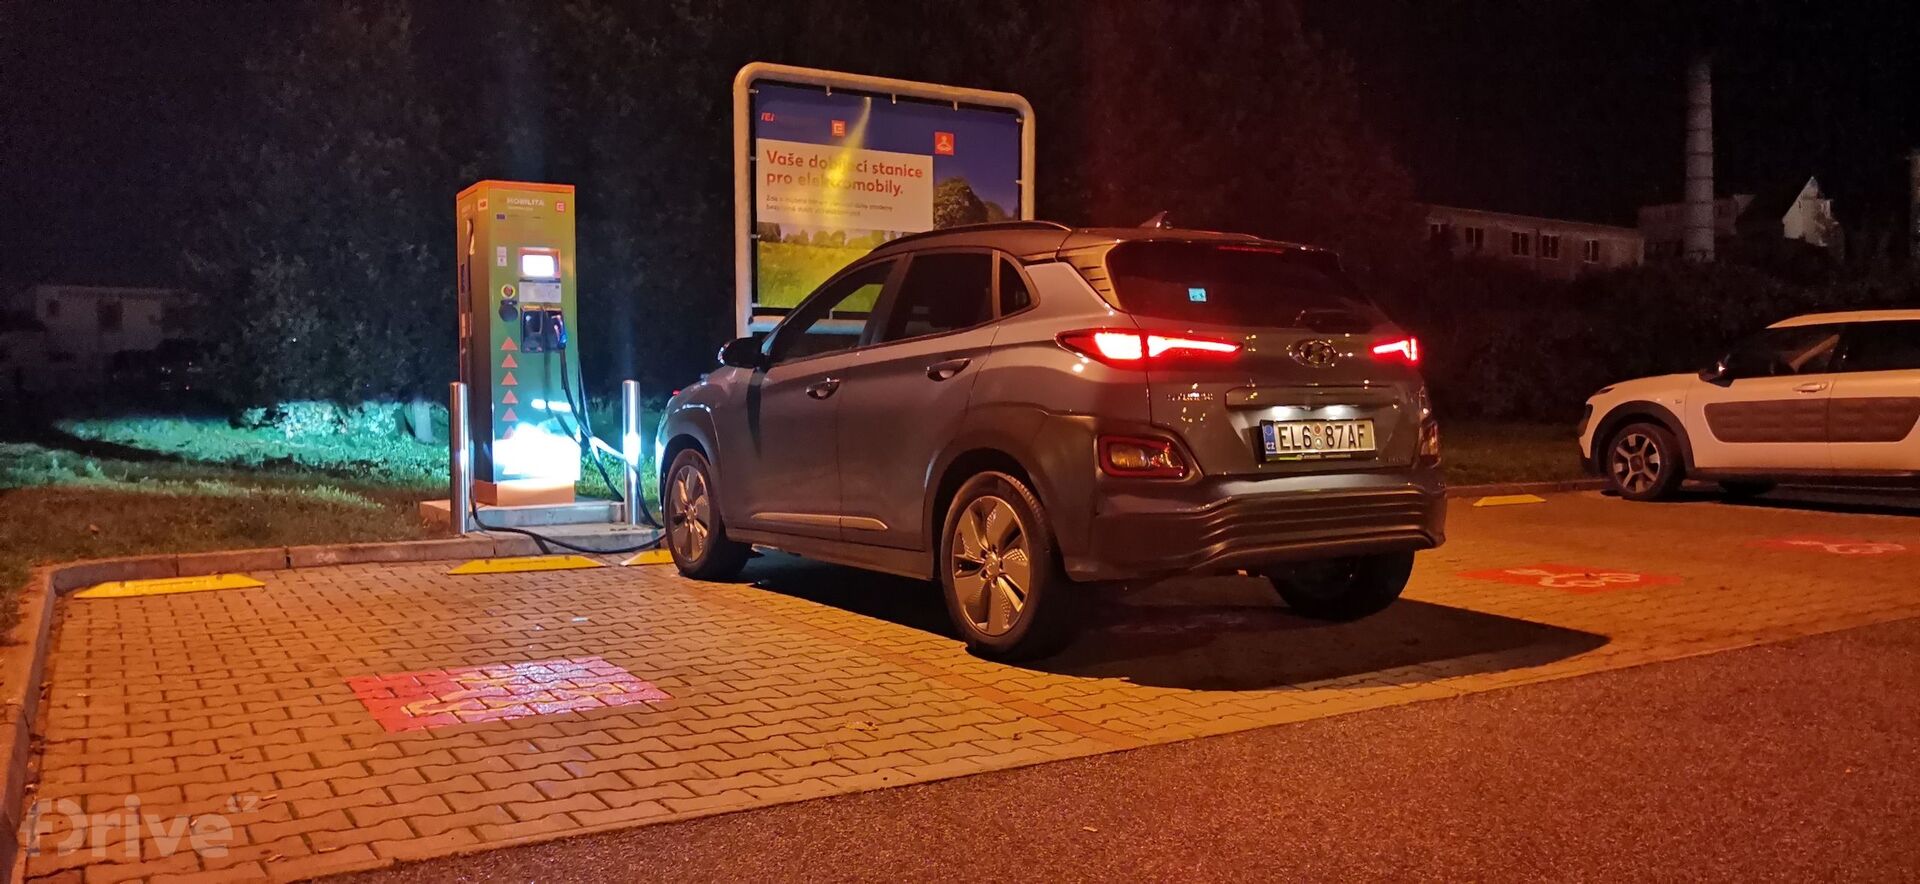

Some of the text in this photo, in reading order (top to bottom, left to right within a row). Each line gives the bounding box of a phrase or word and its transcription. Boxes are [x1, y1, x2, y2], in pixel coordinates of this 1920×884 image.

[766, 149, 924, 178] Vaše dobcí stanice
[766, 172, 793, 187] pro
[1277, 424, 1365, 450] EL6 87AF
